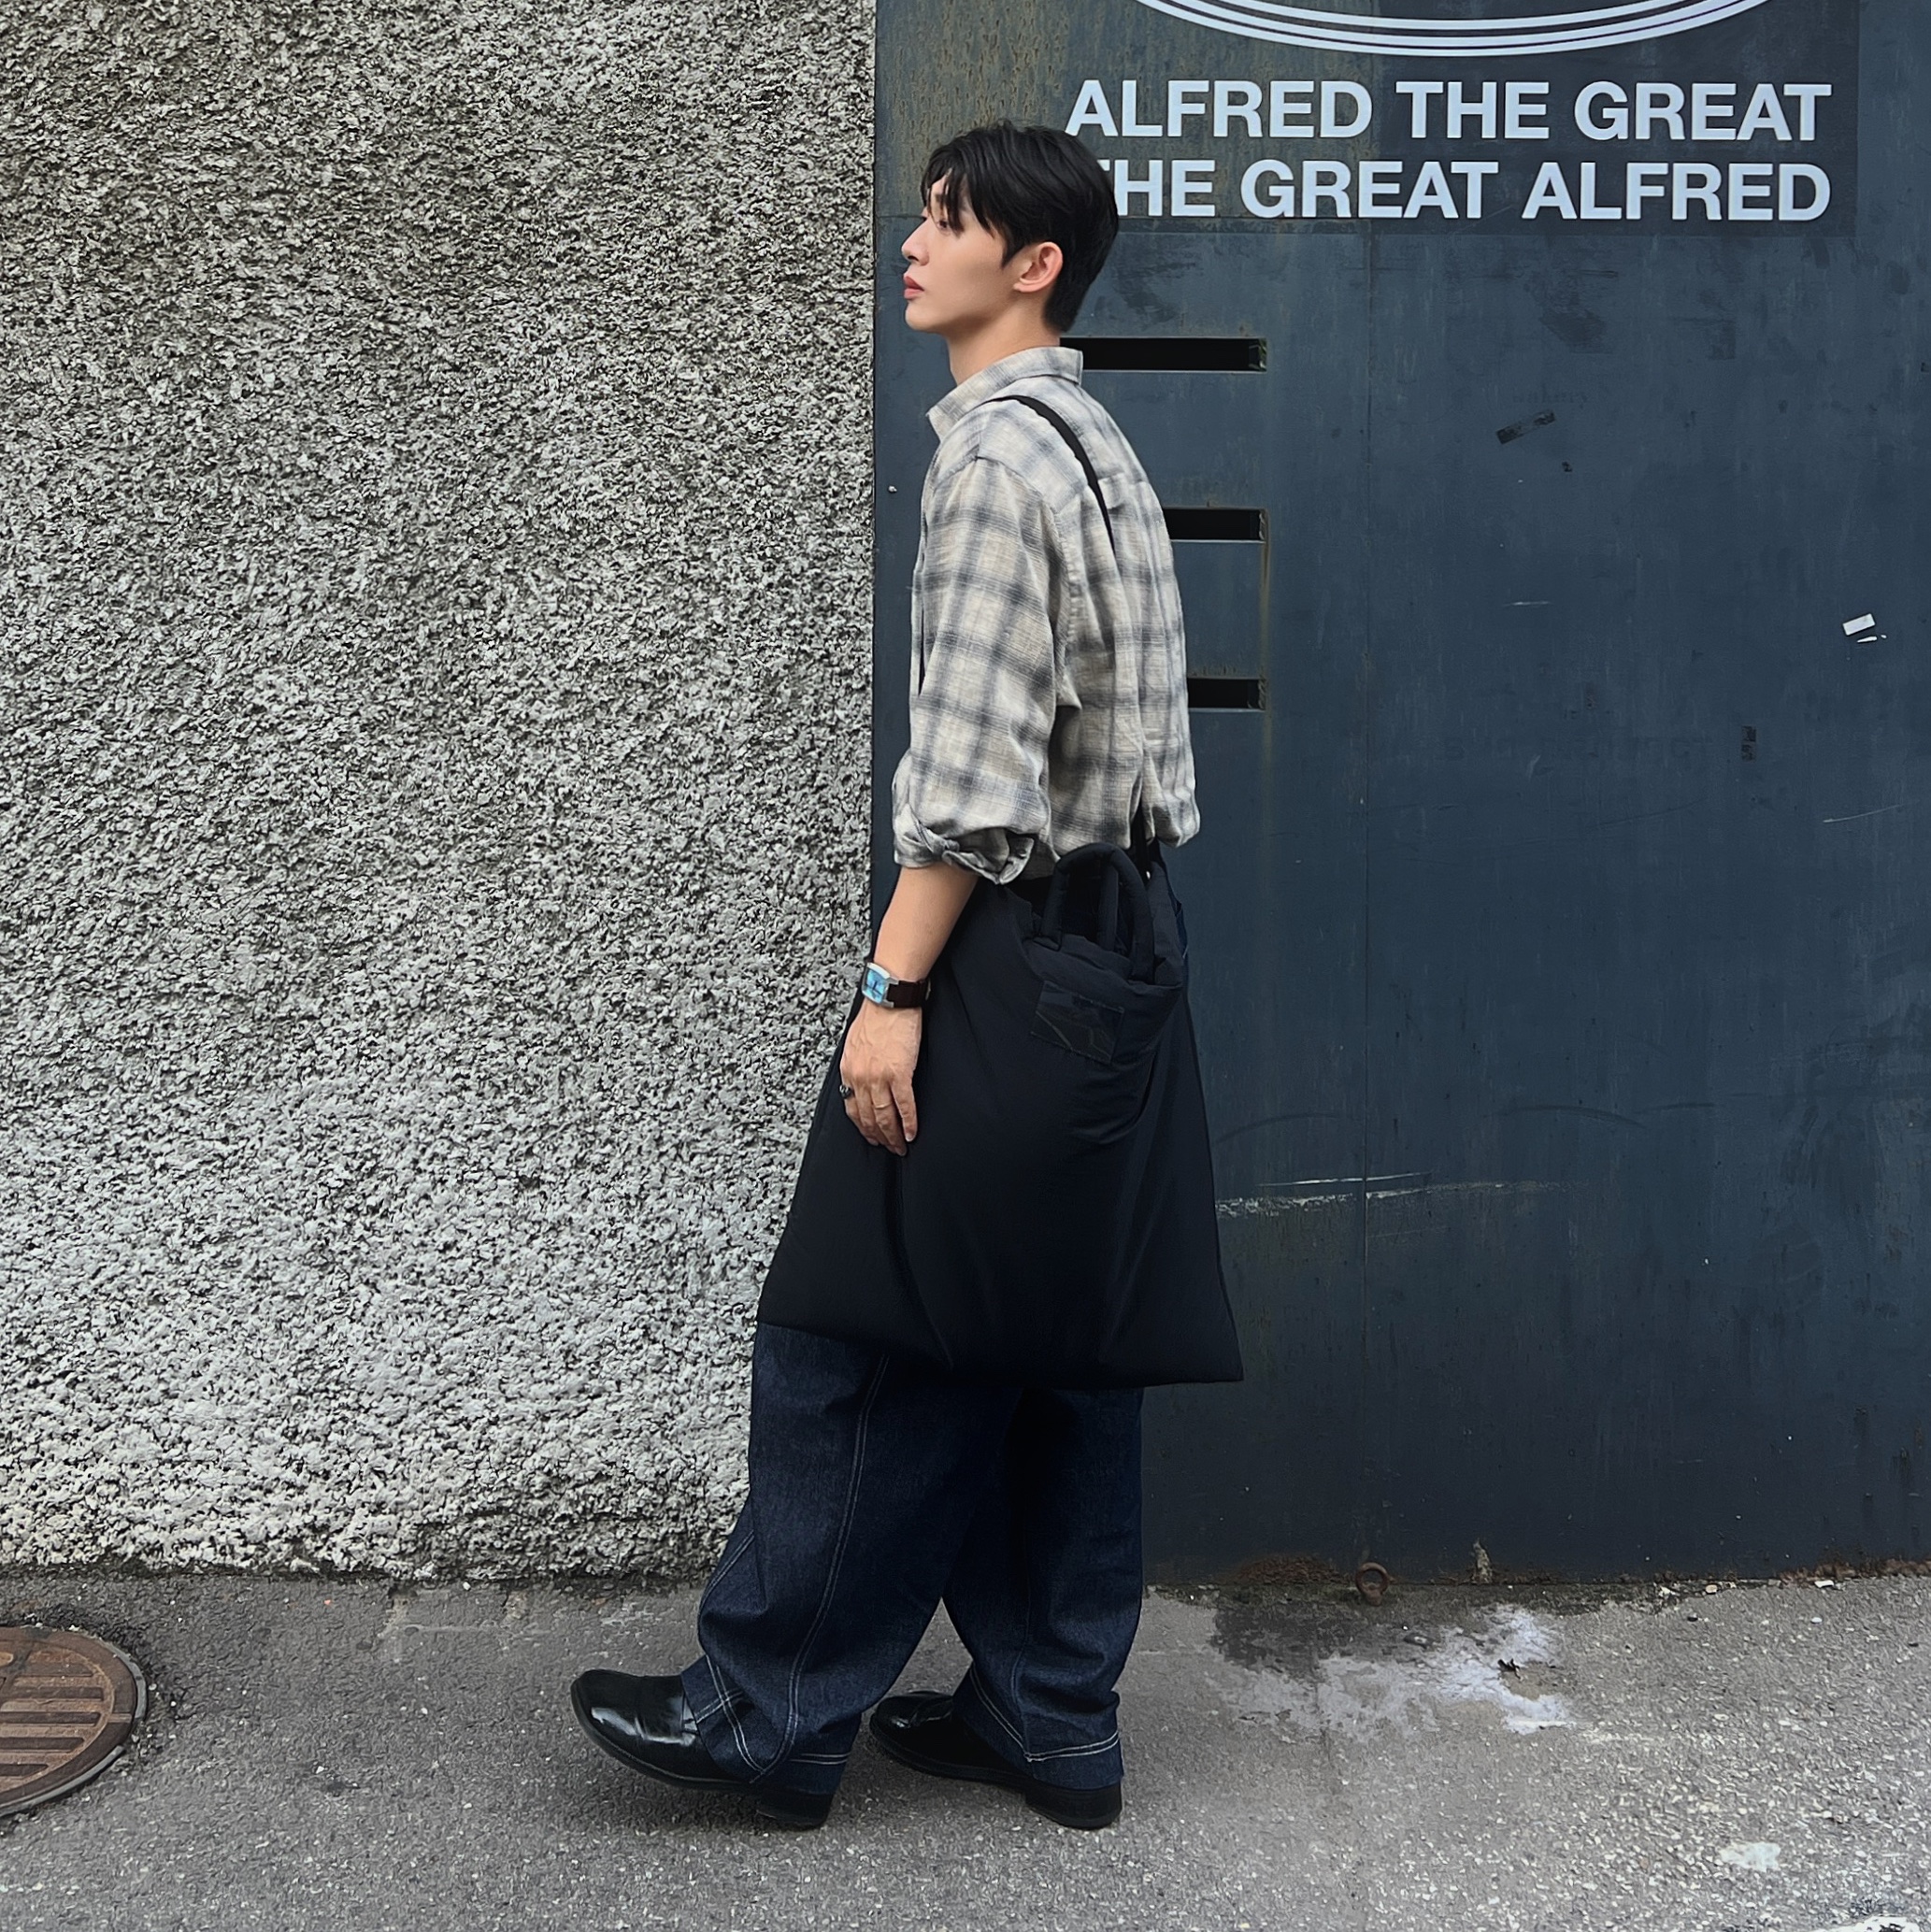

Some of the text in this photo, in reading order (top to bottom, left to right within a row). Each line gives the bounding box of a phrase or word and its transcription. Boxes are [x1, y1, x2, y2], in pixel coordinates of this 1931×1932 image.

[1065, 79, 1832, 141] ALFRED THE GREAT
[1097, 159, 1830, 221] HE GREAT ALFRED
